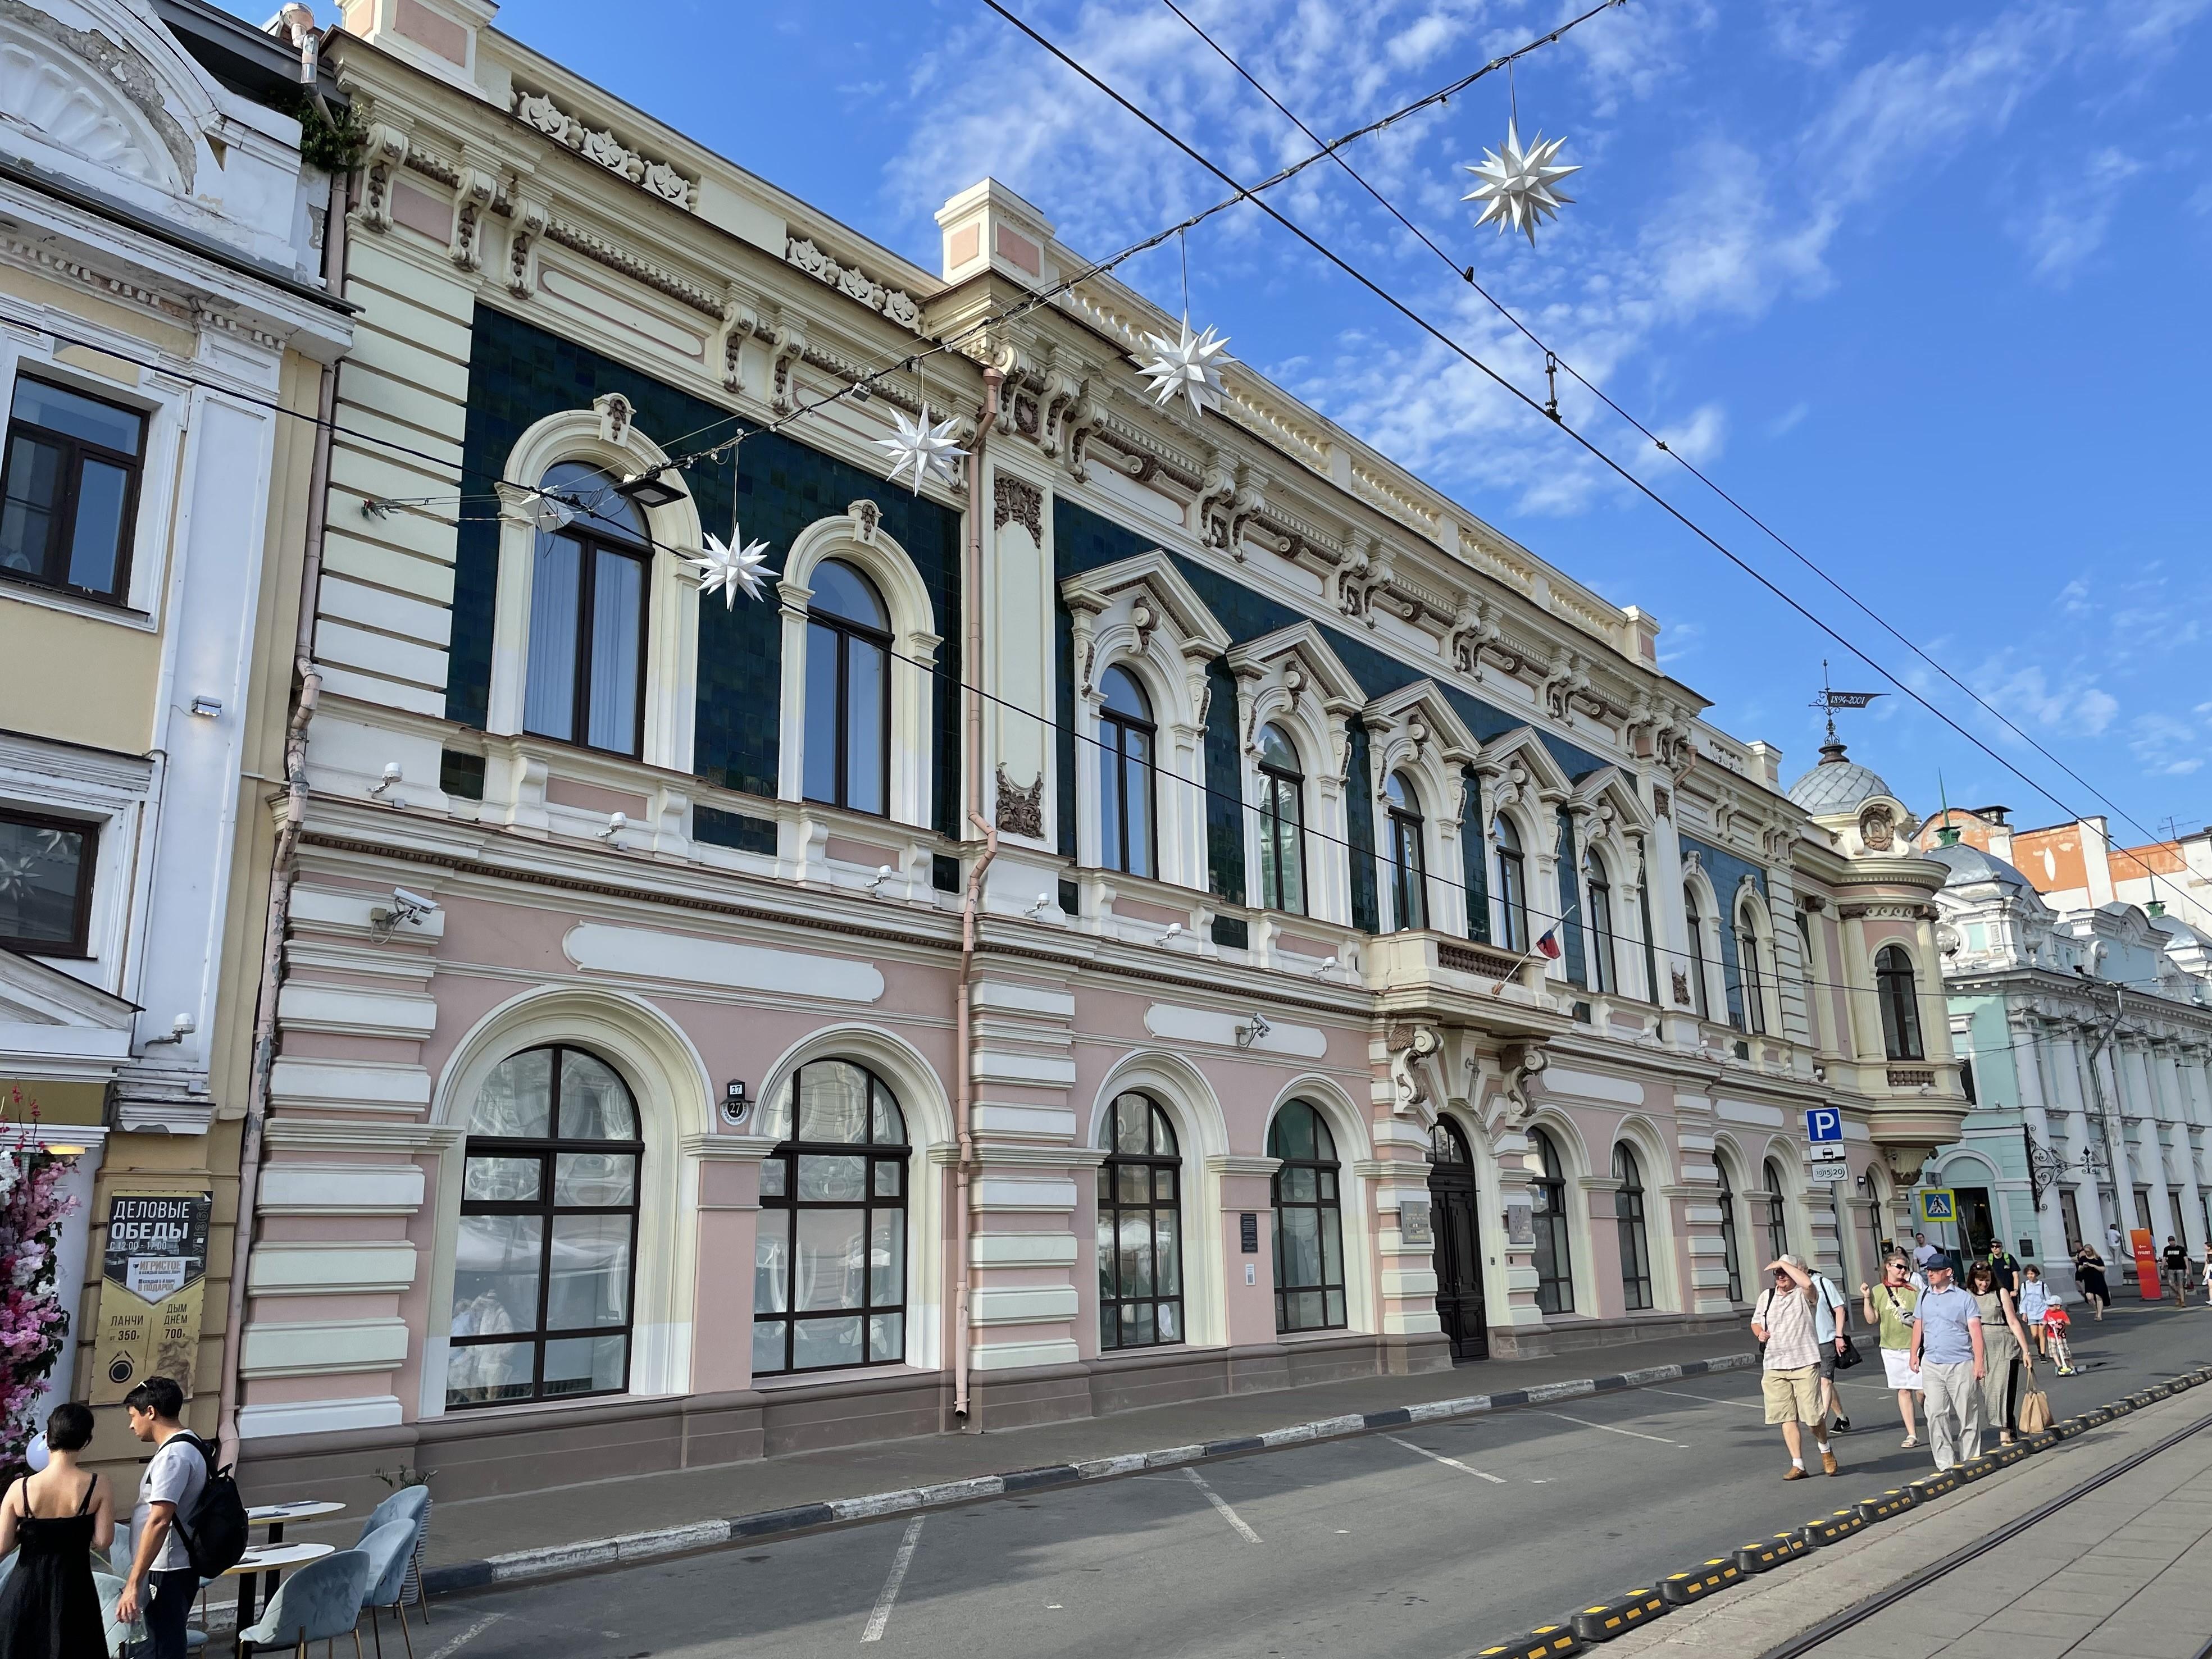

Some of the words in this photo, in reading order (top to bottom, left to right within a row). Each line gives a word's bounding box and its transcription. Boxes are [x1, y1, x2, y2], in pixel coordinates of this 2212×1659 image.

[1831, 695, 1865, 704] 1894-2001
[730, 1102, 741, 1114] 27
[1815, 1113, 1835, 1138] P
[113, 1201, 191, 1220] ДЕЛОВЫЕ
[111, 1222, 189, 1241] ОБЕДЫ
[167, 1304, 187, 1314] ДЫМ
[111, 1315, 143, 1326] ЛАНЧИ
